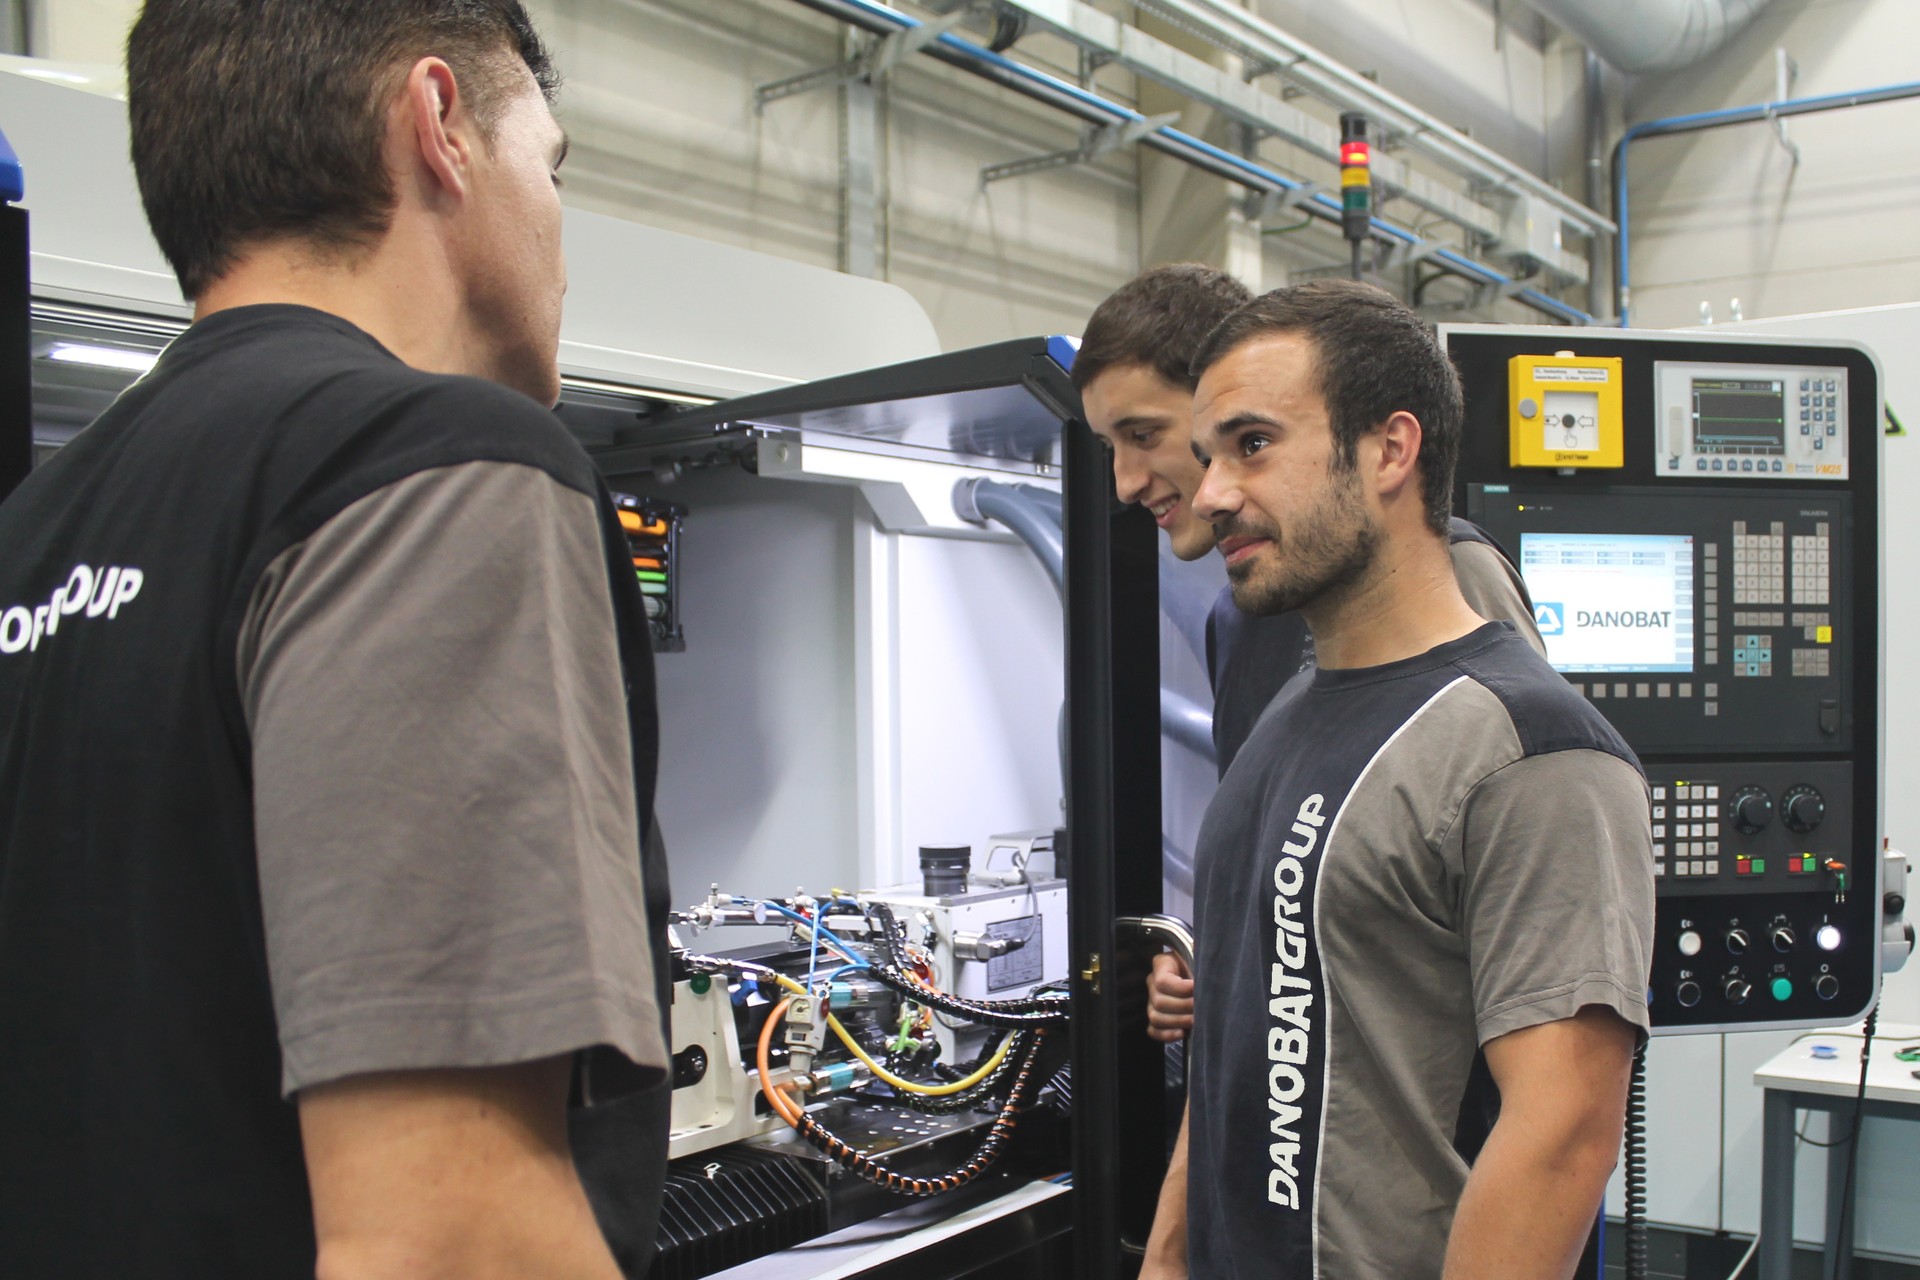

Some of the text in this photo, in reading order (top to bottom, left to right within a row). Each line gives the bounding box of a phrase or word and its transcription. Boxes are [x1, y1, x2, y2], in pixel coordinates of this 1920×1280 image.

[1815, 464, 1842, 474] VM25
[1577, 611, 1671, 628] DANOBAT
[1268, 793, 1325, 1210] DANOBATGROUP
